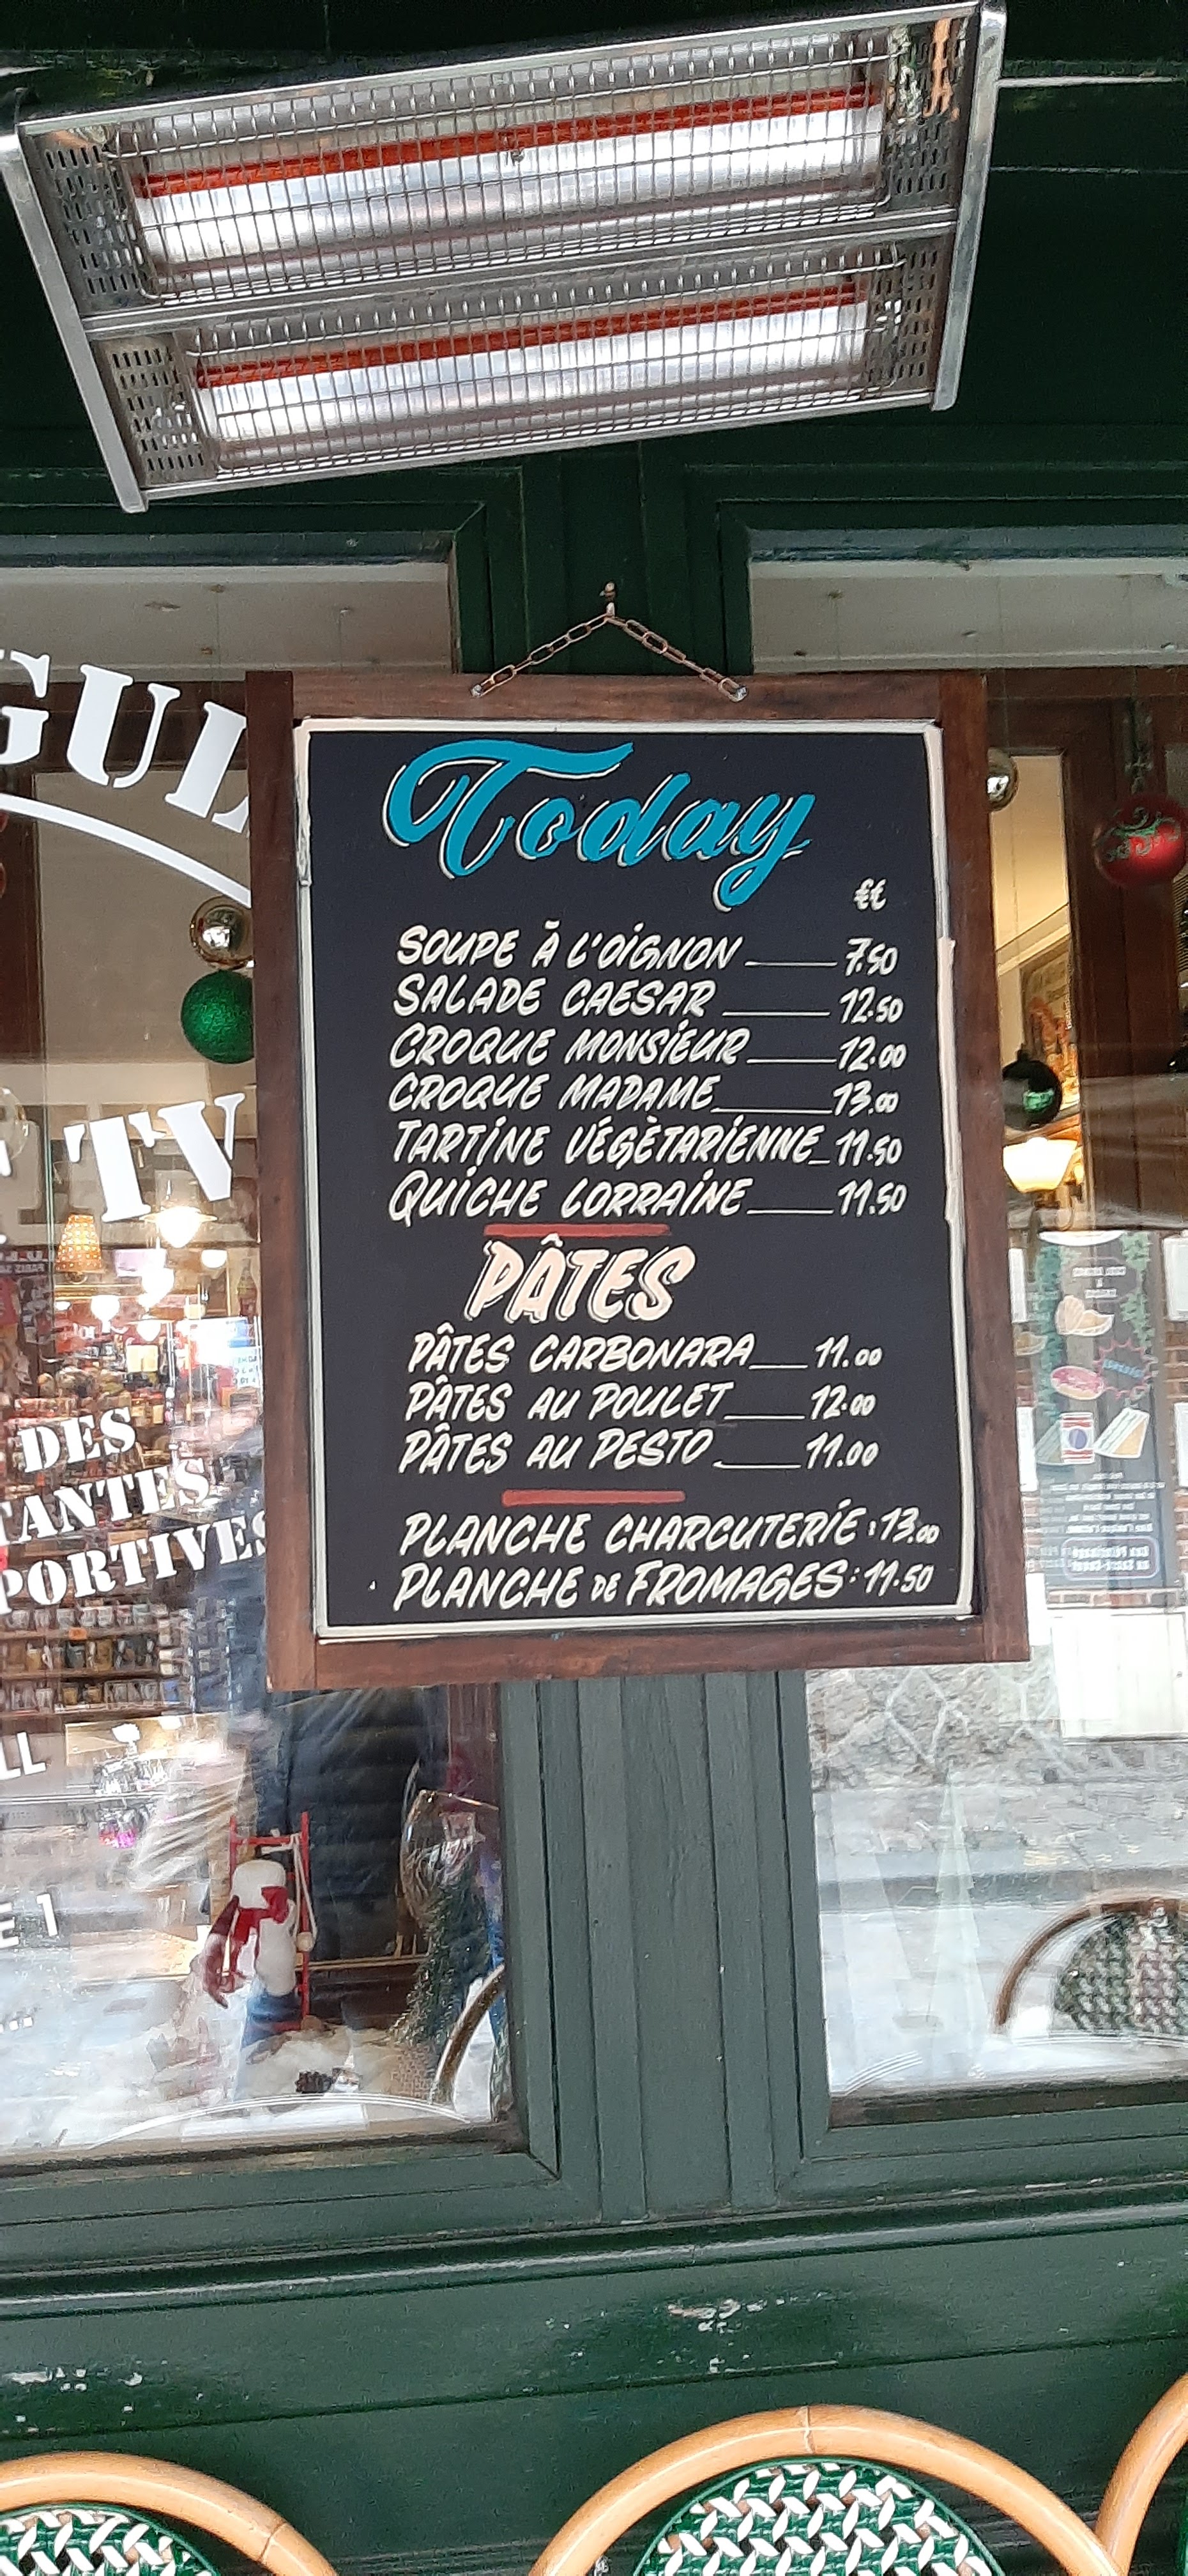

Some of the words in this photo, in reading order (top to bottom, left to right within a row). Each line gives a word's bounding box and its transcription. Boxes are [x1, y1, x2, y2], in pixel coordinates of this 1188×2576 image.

[381, 739, 816, 913] Today
[397, 924, 520, 969] SOUPE
[845, 937, 898, 976] 7.50
[393, 972, 546, 1016] SALADE
[562, 977, 716, 1018] CAESAR
[839, 986, 904, 1024] 12.50
[390, 1022, 556, 1068] CROQUE
[838, 1036, 907, 1073] 12.00
[388, 1071, 550, 1112] CROQUE
[558, 1073, 721, 1112] MADAME
[833, 1080, 900, 1117] 13.00
[63, 1092, 246, 1222] TV
[835, 1128, 902, 1167] 11.50
[837, 1178, 908, 1217] 11.50
[463, 1234, 696, 1324] PÂTES
[407, 1322, 515, 1373] PÂTES
[529, 1335, 756, 1371] CARBONARA
[815, 1334, 883, 1368] 11.00
[404, 1375, 513, 1422] PÂTES
[528, 1386, 581, 1420] AU
[589, 1384, 735, 1420] POULET
[811, 1384, 876, 1420] 12.00
[17, 1407, 135, 1473] DES
[399, 1423, 512, 1475] PÂTES
[526, 1434, 584, 1470] AU
[589, 1428, 713, 1466] PESTO
[806, 1432, 880, 1469] 11.00
[399, 1512, 591, 1558] PLANCHE
[393, 1561, 583, 1611] PLANCHE
[590, 1572, 621, 1602] DE
[864, 1559, 934, 1597] 11.50
